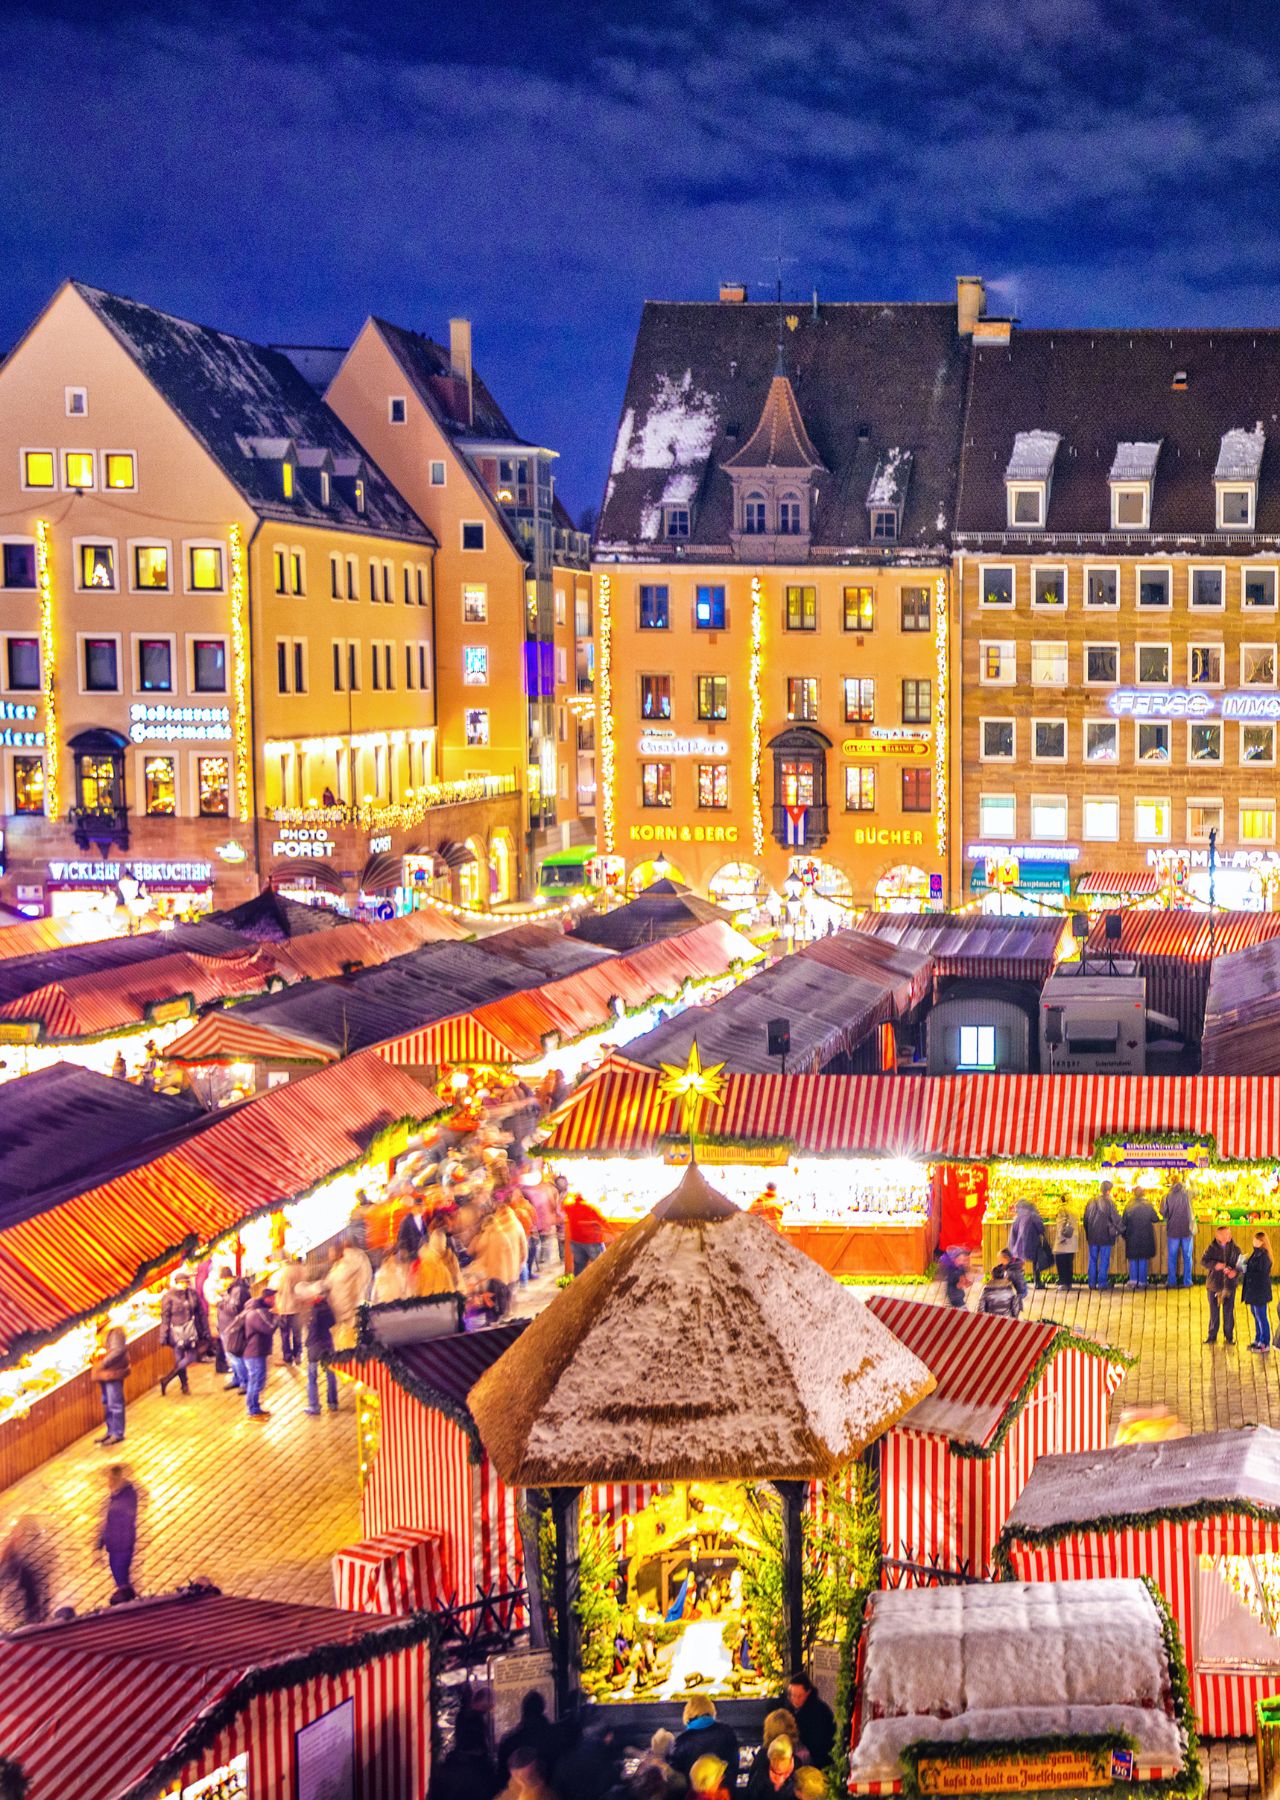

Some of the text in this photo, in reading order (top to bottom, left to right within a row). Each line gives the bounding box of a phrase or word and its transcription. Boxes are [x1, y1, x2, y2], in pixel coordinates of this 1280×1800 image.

[130, 703, 229, 721] Restaurant
[280, 829, 327, 841] PHOTO
[629, 825, 738, 842] KORN & BERG
[855, 828, 923, 845] BÜCHER
[272, 841, 335, 857] PORST
[370, 835, 391, 854] PORST
[49, 863, 212, 881] WICKLEIN EBKUCHEN
